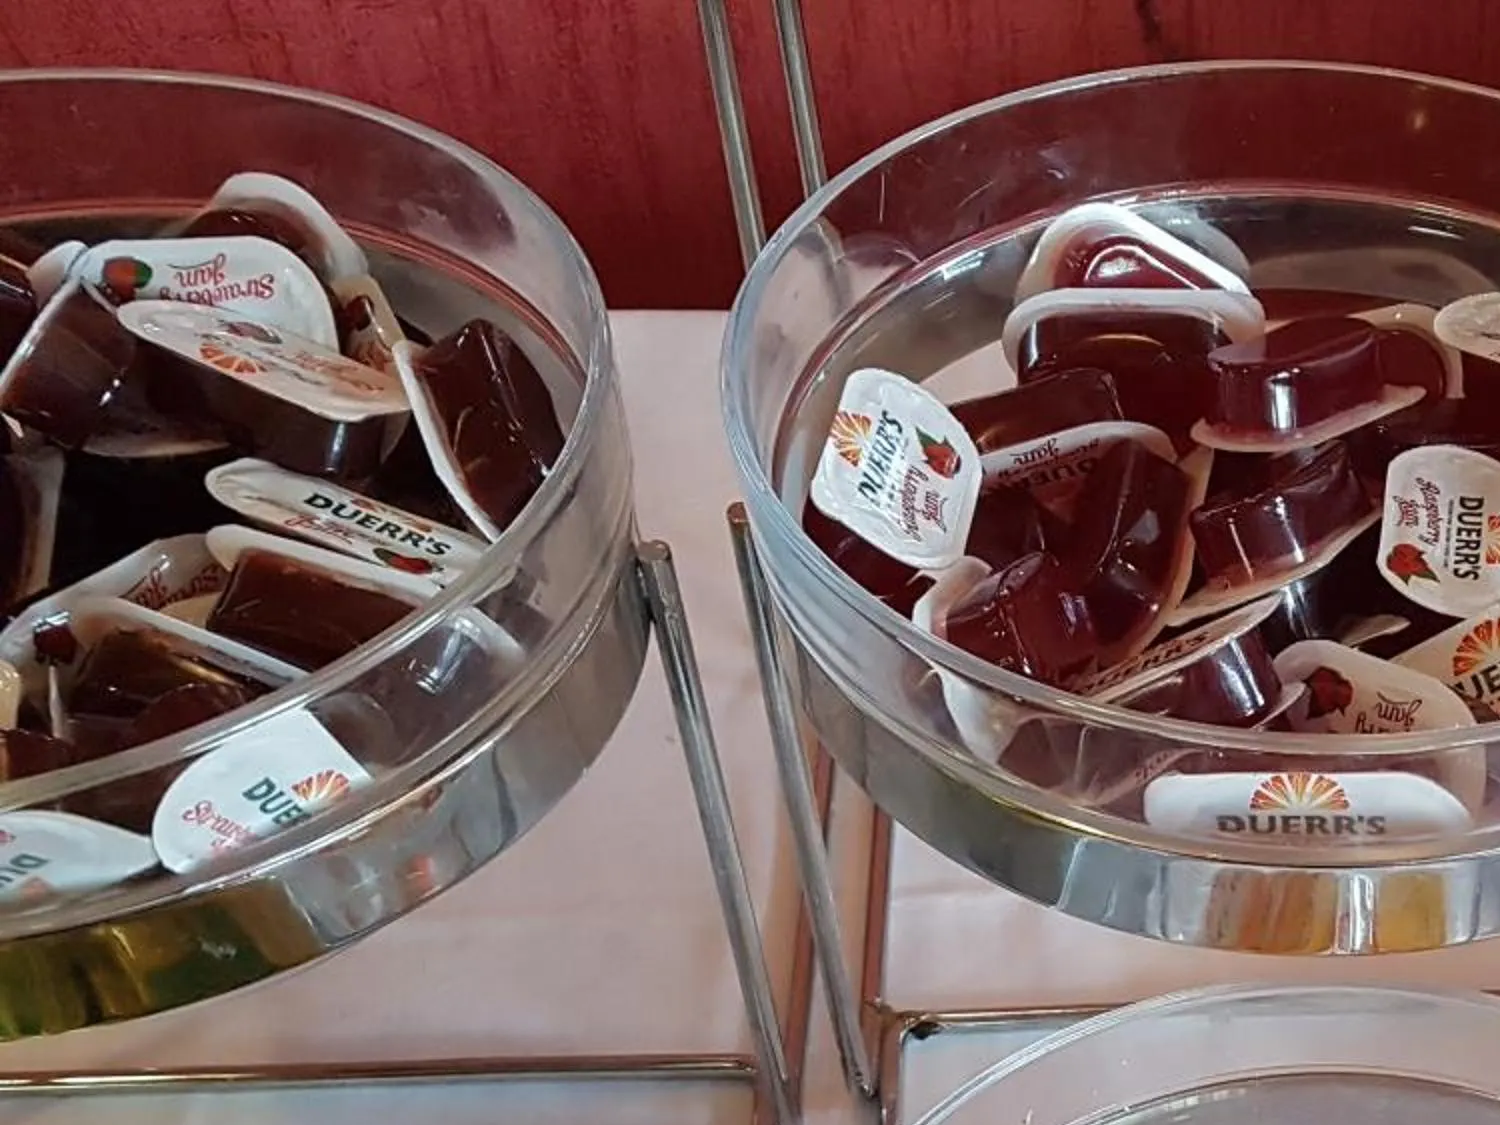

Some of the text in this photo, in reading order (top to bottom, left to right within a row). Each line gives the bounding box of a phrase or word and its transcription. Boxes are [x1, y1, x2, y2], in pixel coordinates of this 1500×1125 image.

[857, 410, 903, 506] DUERR'S
[302, 492, 452, 556] DUERR'S
[1453, 496, 1485, 580] DUERR'S
[1215, 814, 1387, 836] DUERR'S
